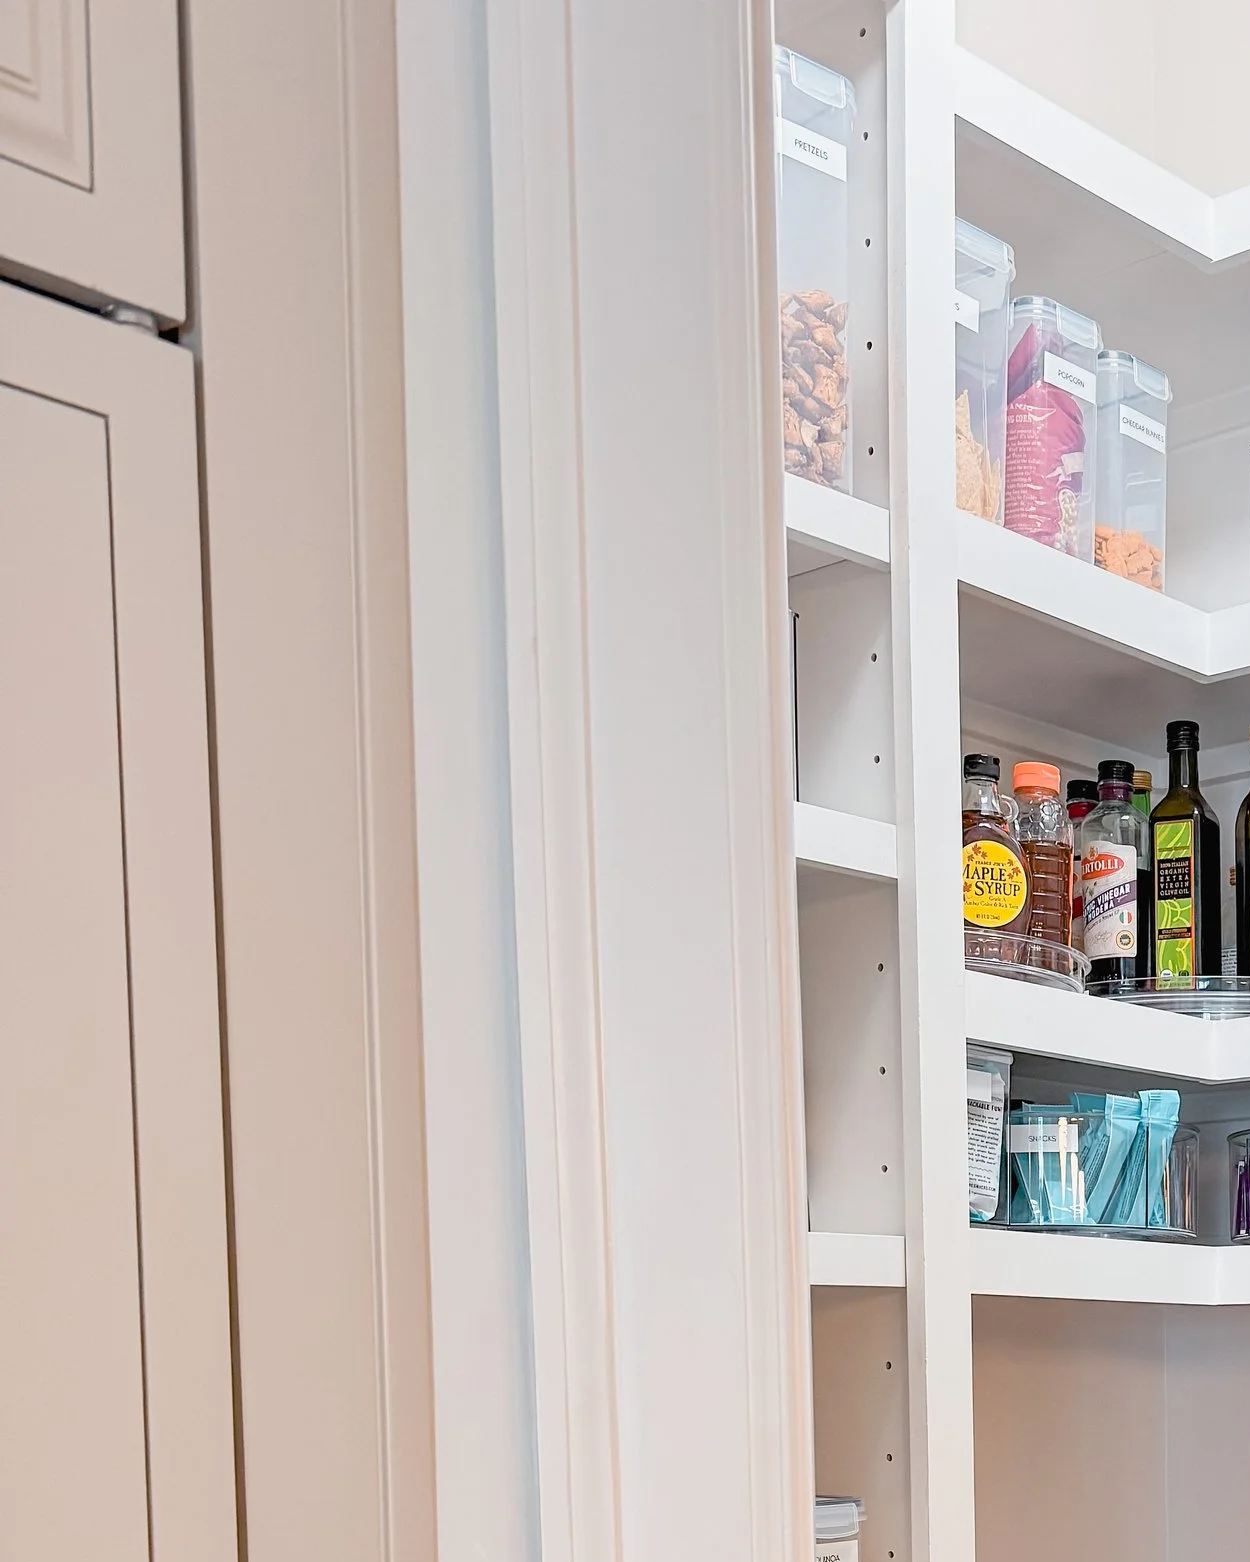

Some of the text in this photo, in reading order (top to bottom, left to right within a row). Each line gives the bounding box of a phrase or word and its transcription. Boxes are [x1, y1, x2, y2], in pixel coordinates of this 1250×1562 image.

[794, 138, 829, 161] PRETZELS
[1057, 369, 1086, 389] POPCORN
[1121, 416, 1145, 432] CHEDDAR
[1160, 867, 1189, 876] ORGANIC
[974, 880, 1021, 897] SYRUP
[1160, 881, 1190, 889] VIRGIN
[1160, 889, 1178, 897] OLIVE
[1097, 883, 1131, 906] VINEGAR
